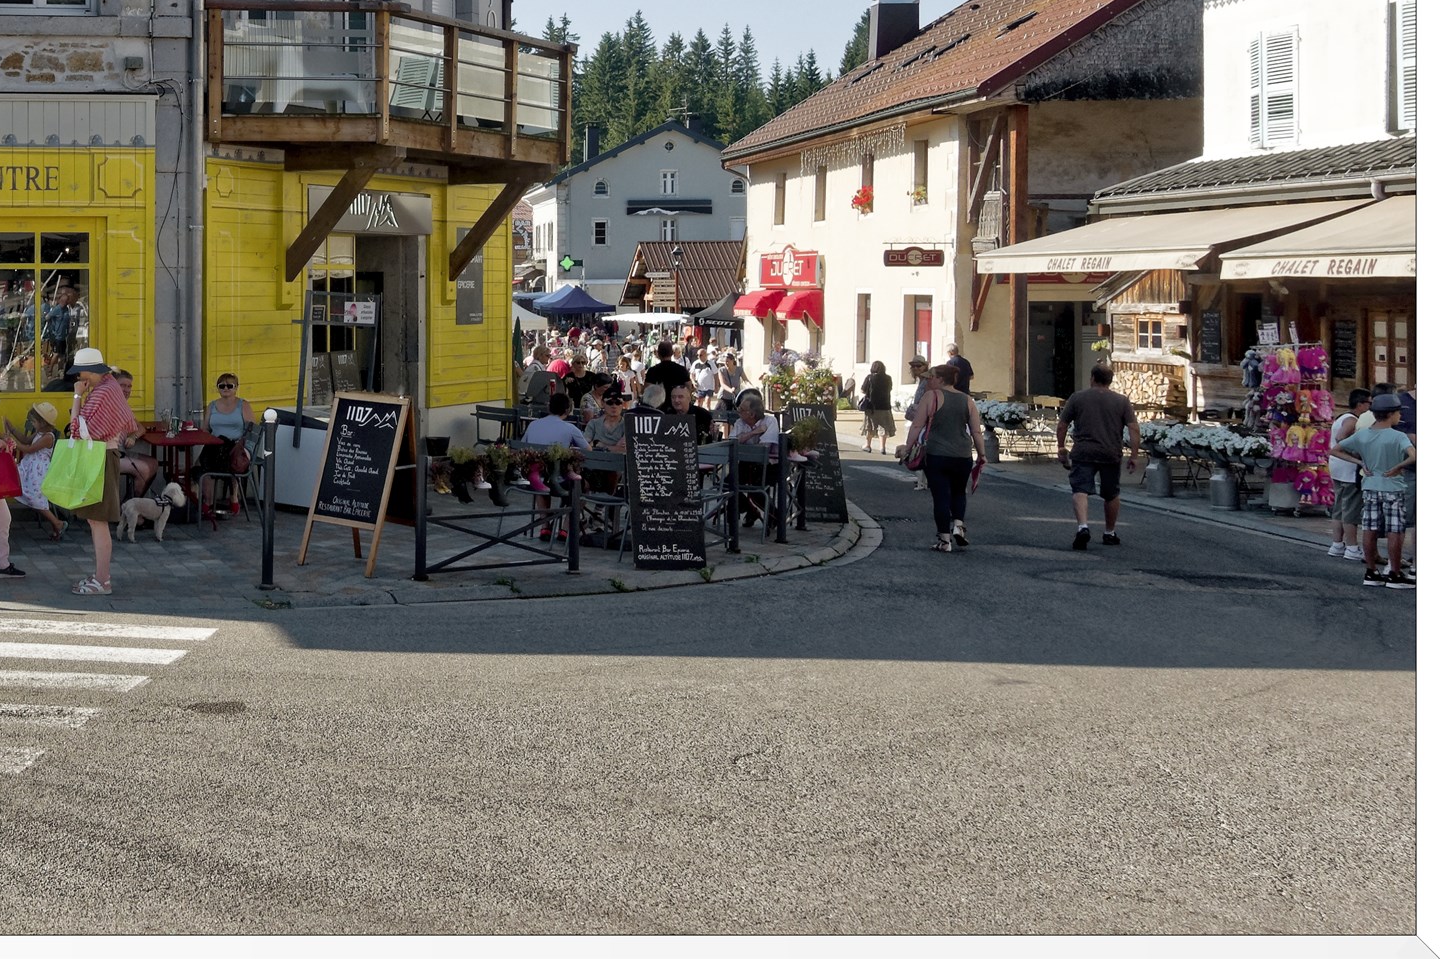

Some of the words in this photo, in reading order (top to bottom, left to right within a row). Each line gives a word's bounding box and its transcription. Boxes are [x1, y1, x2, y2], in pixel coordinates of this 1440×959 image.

[888, 253, 937, 262] DUCRET
[1047, 257, 1076, 271] CHALET
[1080, 256, 1112, 270] REGAIN
[1271, 259, 1320, 275] CHALET
[1327, 258, 1378, 275] REGAIN
[346, 405, 373, 423] 1107
[634, 416, 662, 435] 1107
